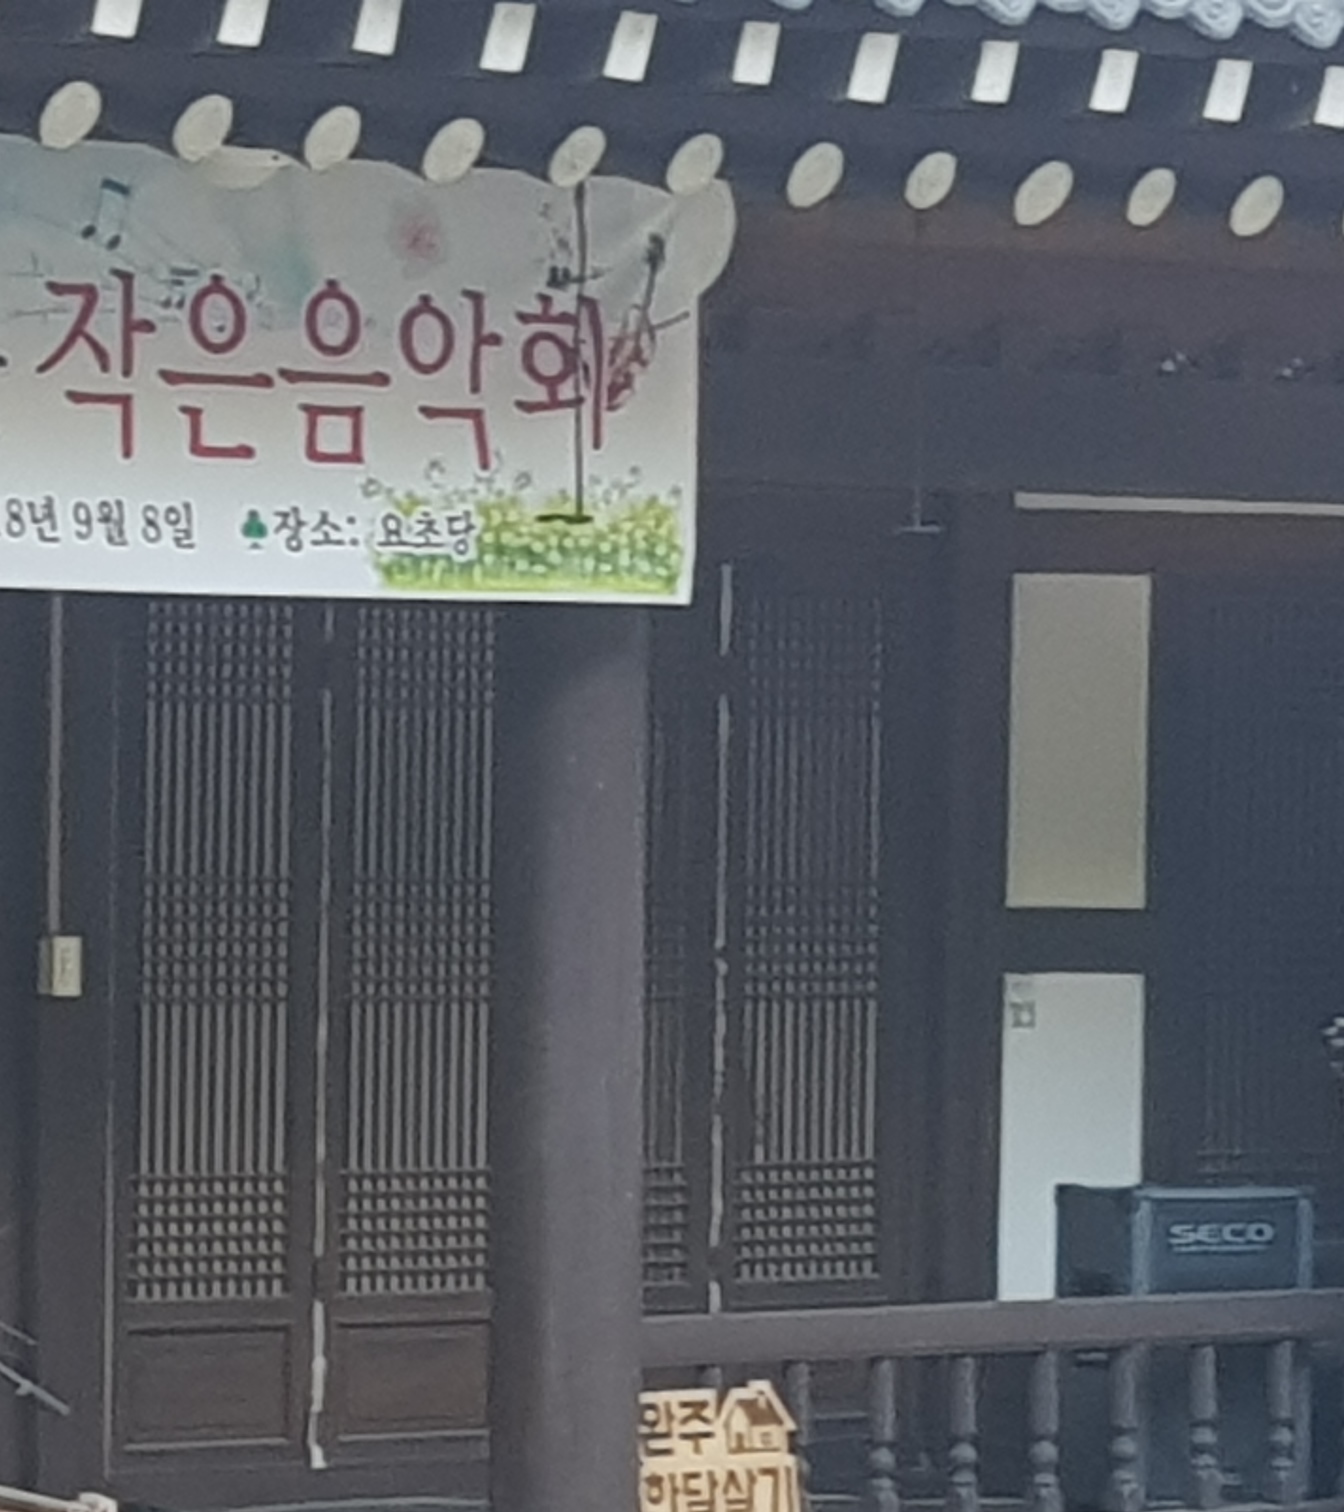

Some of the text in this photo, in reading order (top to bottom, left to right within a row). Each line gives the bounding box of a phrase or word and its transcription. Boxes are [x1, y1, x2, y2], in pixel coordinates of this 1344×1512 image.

[72, 500, 128, 548] 9월
[140, 502, 196, 550] 8일
[272, 505, 360, 554] 장소:
[376, 509, 477, 557] 요초당
[1168, 1222, 1275, 1245] SECO
[638, 1399, 716, 1458] 완주
